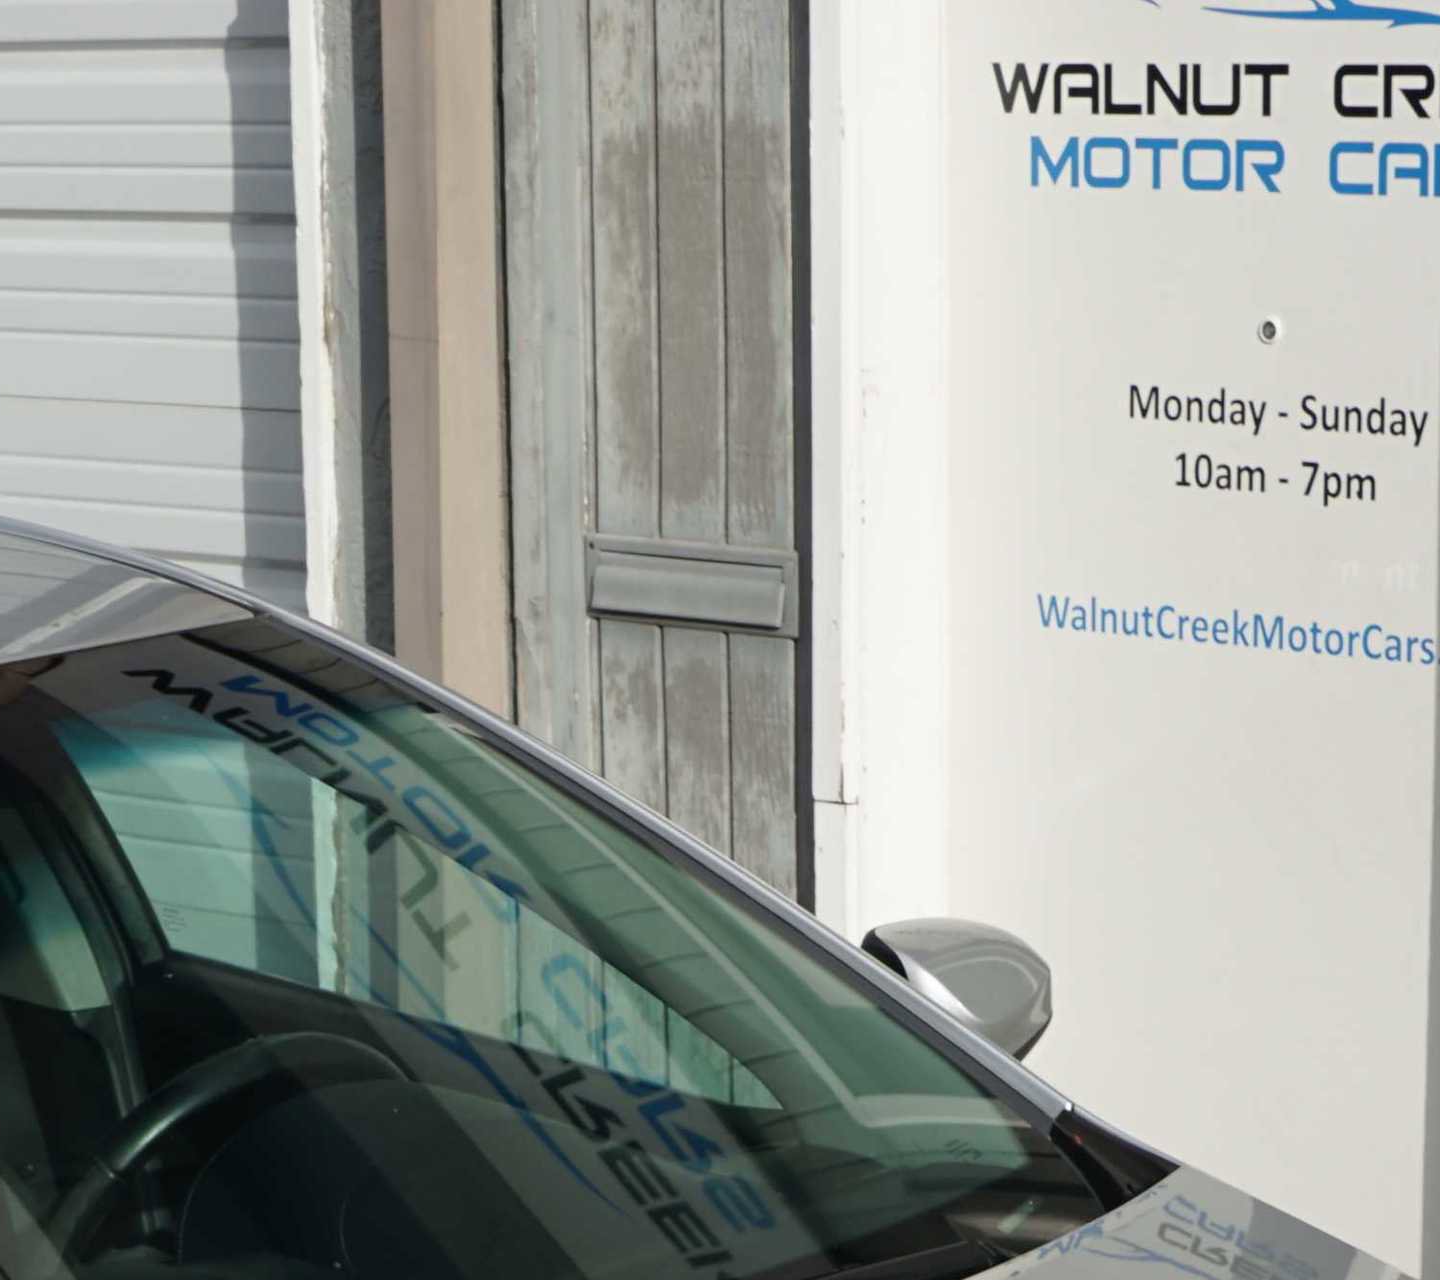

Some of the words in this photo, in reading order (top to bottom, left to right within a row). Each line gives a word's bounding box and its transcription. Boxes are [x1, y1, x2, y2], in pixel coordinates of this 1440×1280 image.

[992, 62, 1290, 116] WALNUT
[1030, 135, 1286, 193] MOTOR
[1128, 385, 1267, 434] Monday
[1299, 395, 1429, 448] Sunday
[1173, 453, 1267, 495] 10am
[1301, 462, 1377, 506] 7pm
